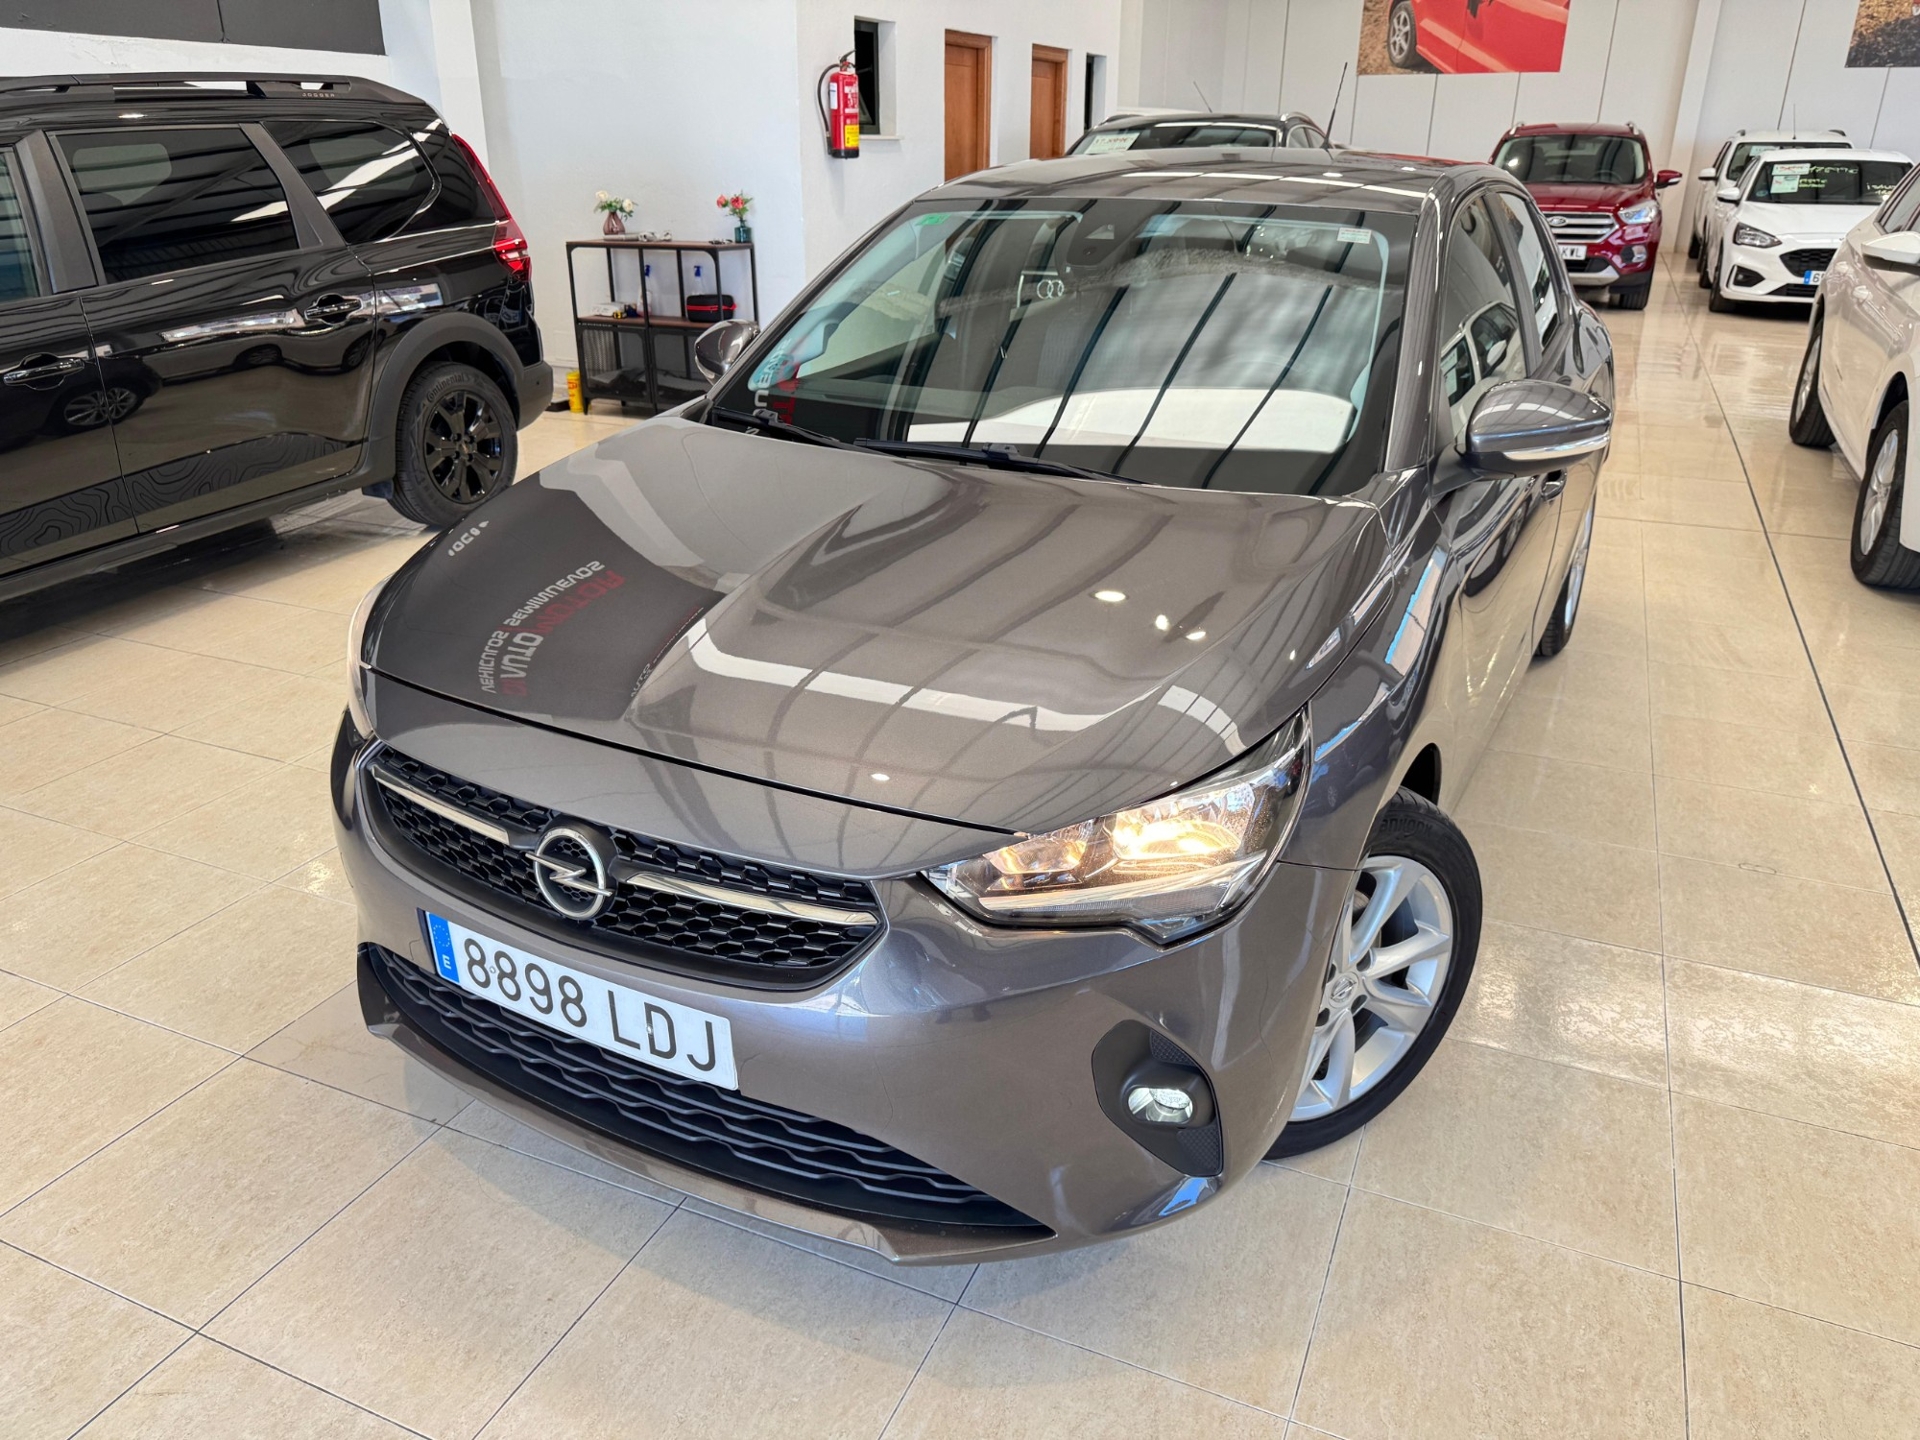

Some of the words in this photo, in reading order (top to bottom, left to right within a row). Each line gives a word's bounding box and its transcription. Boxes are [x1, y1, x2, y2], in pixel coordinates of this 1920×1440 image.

[426, 372, 465, 403] Continental
[442, 953, 452, 970] E
[464, 938, 588, 1029] 8898
[608, 989, 717, 1073] LDJ
